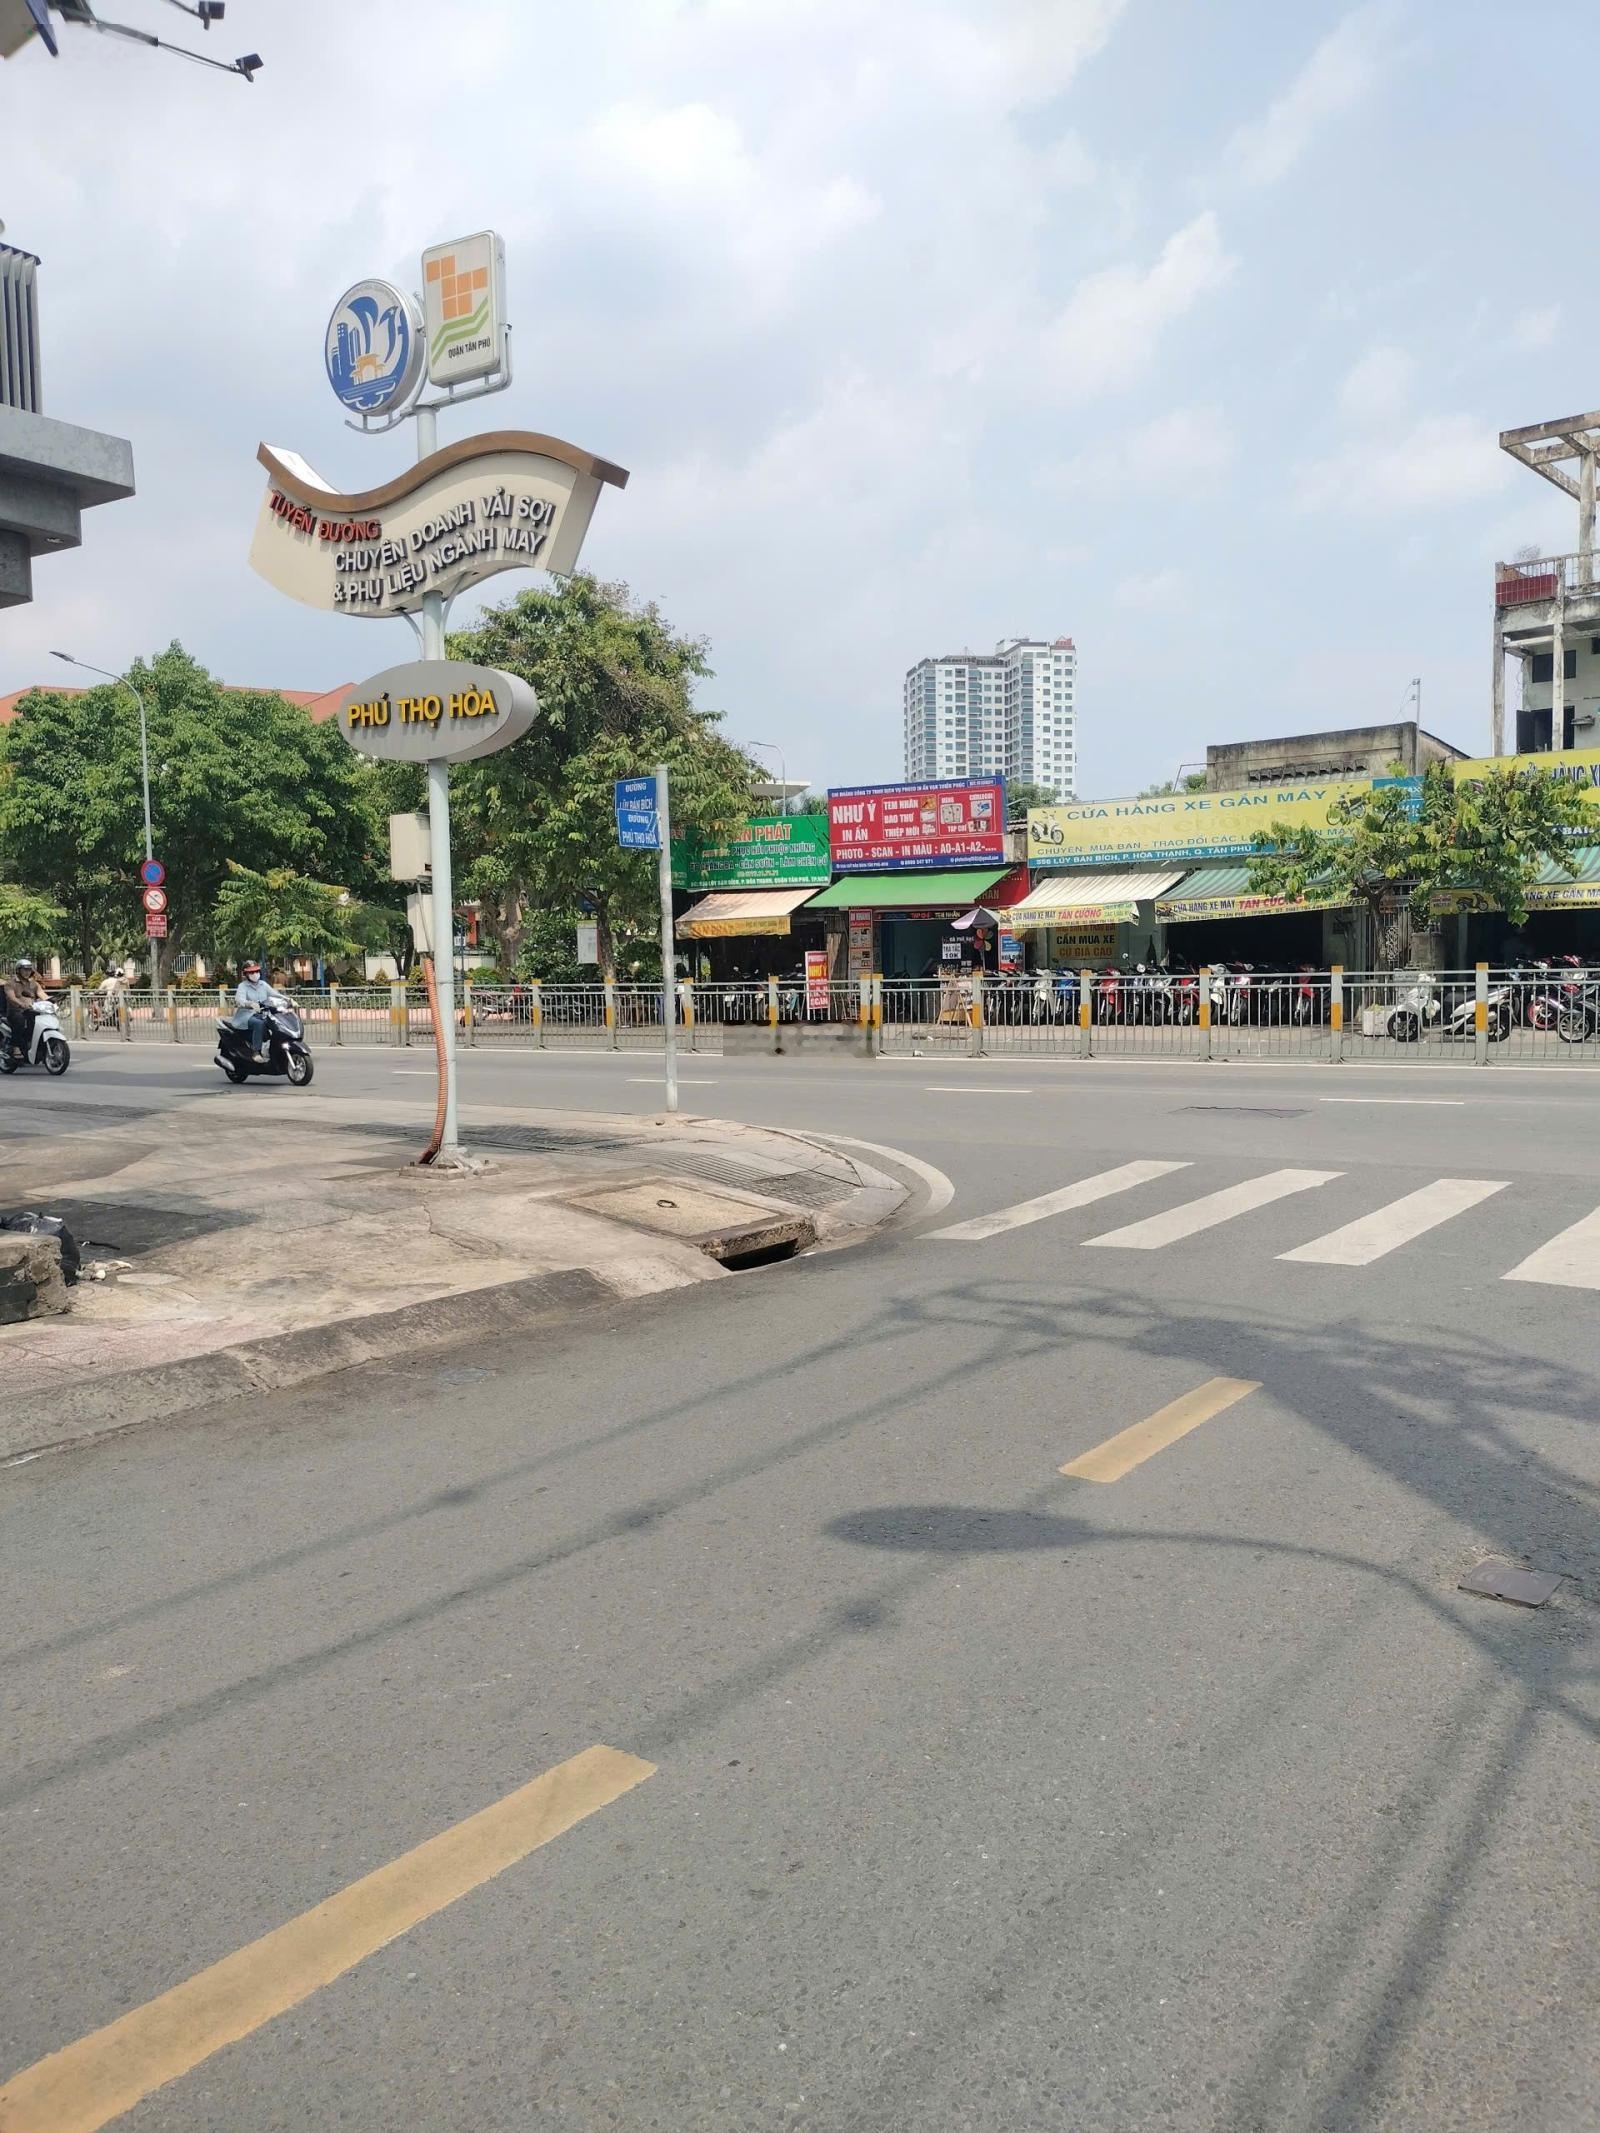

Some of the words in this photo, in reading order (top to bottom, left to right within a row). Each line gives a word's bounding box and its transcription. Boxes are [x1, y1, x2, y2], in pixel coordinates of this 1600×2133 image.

[269, 489, 316, 535] TUYẾN
[318, 517, 381, 542] ĐƯỜNG
[335, 539, 405, 572] CHUYÊN
[411, 501, 474, 552] DOANH
[480, 486, 513, 519] VẢI
[517, 496, 556, 527] SỢI
[388, 560, 426, 595] LIỆU
[430, 526, 494, 574] NGÀNH
[502, 527, 546, 554] MAY
[396, 694, 442, 728] THỌ
[449, 682, 498, 718] HÒA
[832, 802, 865, 824] NHƯ
[866, 799, 877, 822] Ý
[884, 801, 899, 811] TEM
[1067, 806, 1107, 821] CỬA
[1116, 801, 1177, 817] HÀNG
[1184, 800, 1212, 812] XE
[1277, 789, 1326, 803] MÁY
[842, 830, 853, 841] IN
[855, 825, 869, 841] ẤN
[836, 847, 863, 860] PHOTO
[871, 846, 894, 858] SCAN
[901, 845, 911, 856] IN
[912, 843, 933, 856] MÀU
[1089, 843, 1115, 852] MUA
[1153, 838, 1184, 848] TRAO
[1079, 934, 1100, 945] MUA
[1103, 934, 1115, 944] XE
[1093, 946, 1112, 957] CAO
